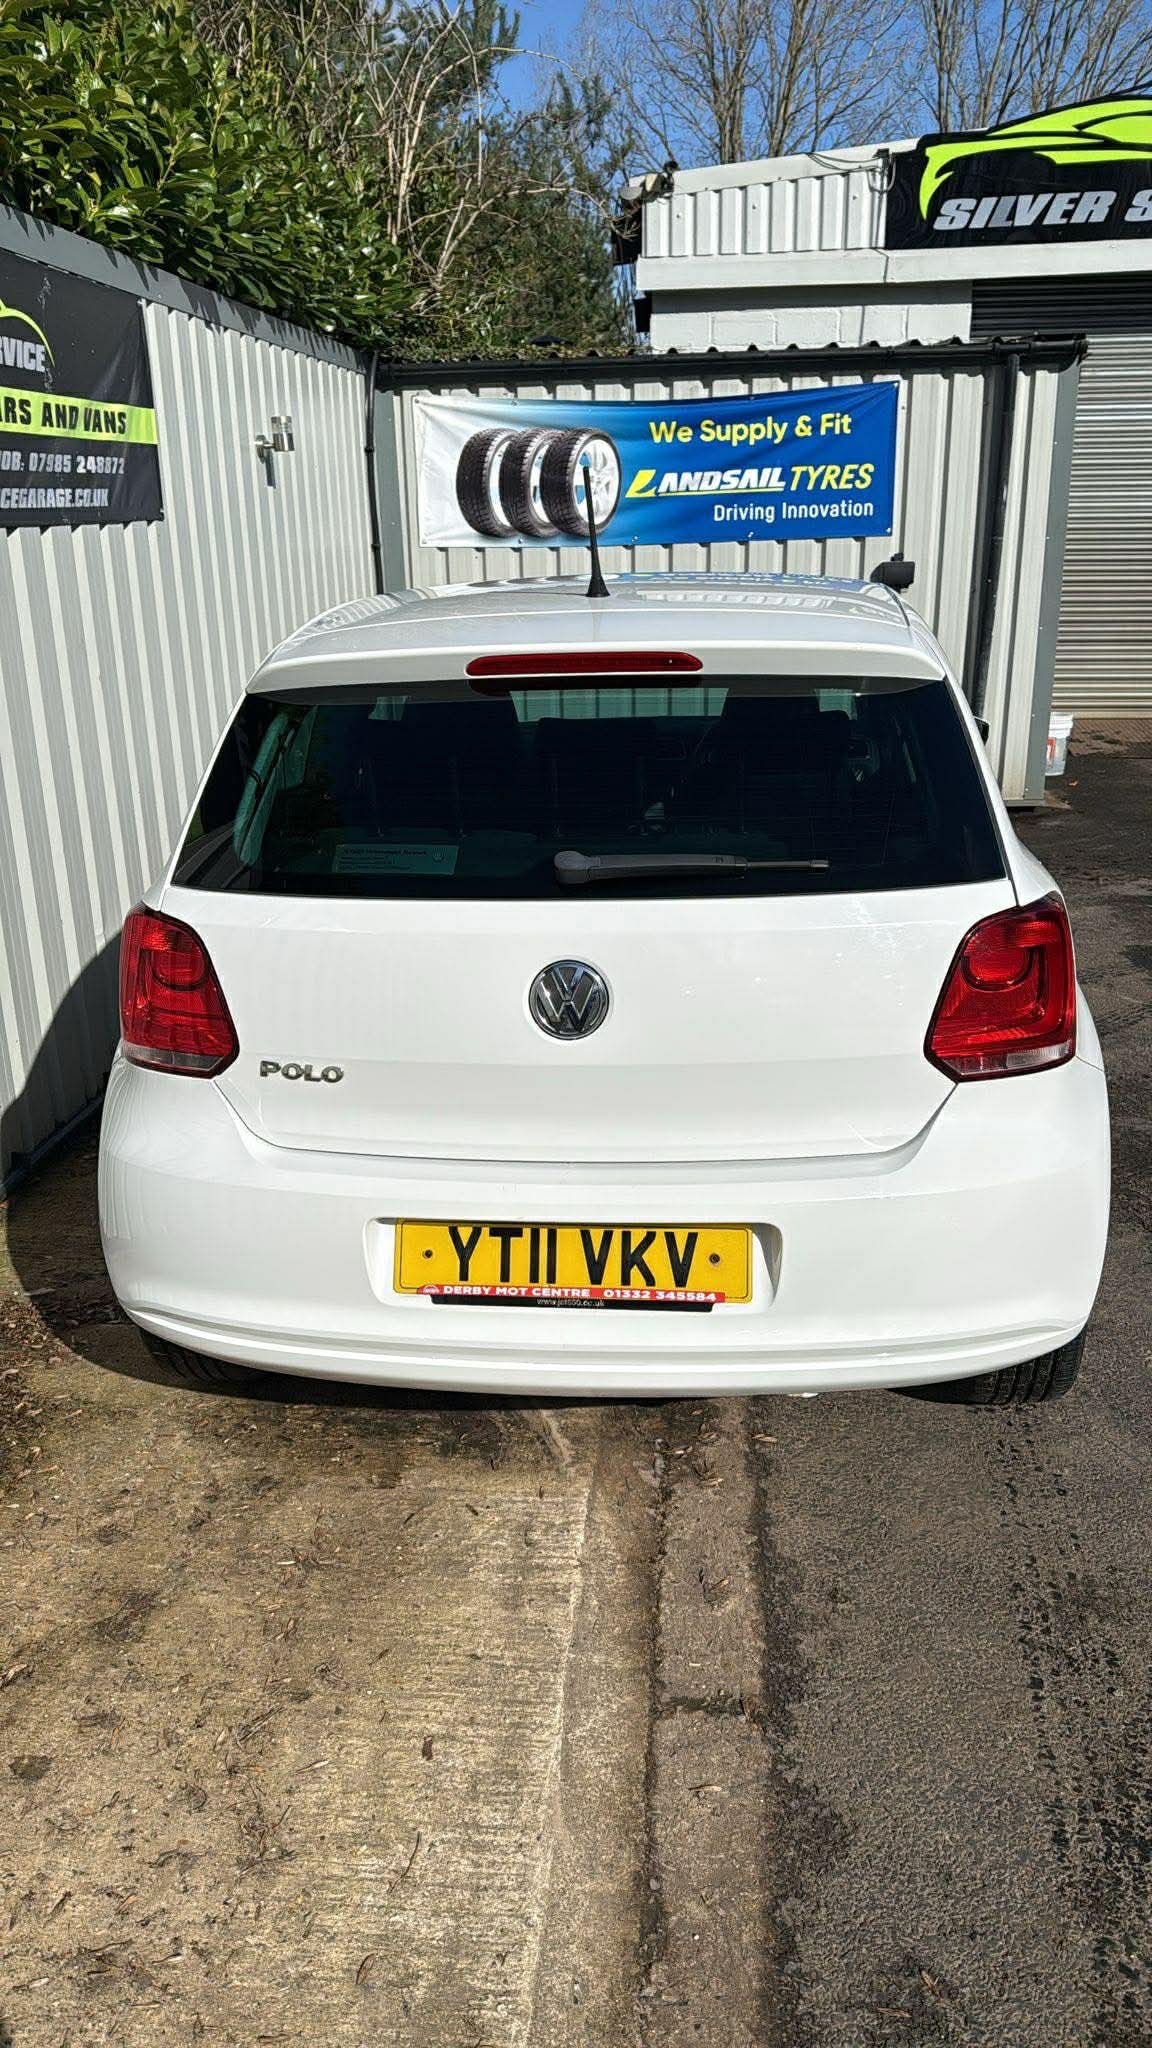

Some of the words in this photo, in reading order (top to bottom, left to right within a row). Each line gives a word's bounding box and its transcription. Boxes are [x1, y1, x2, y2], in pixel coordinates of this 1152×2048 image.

[932, 190, 1117, 231] SILVER
[0, 335, 46, 373] VICE
[0, 395, 32, 426] RS
[41, 401, 79, 431] AND
[83, 406, 127, 435] VANS
[649, 421, 693, 443] We
[700, 416, 788, 446] Supply
[794, 415, 813, 437] &
[820, 412, 852, 436] Fit
[0, 450, 24, 472] OB:
[28, 452, 72, 473] 07985
[625, 467, 786, 498] LANDSAIL
[790, 463, 875, 491] TYRES
[713, 504, 775, 523] Driving
[782, 500, 874, 519] Innovation
[259, 1060, 344, 1083] POLO
[448, 1225, 557, 1285] YT11
[580, 1229, 699, 1288] VKV
[443, 1286, 492, 1295] DERBY
[495, 1287, 528, 1296] MOT
[531, 1287, 591, 1298] CENTRE
[603, 1289, 650, 1299] 01332
[655, 1291, 717, 1301] 345584
